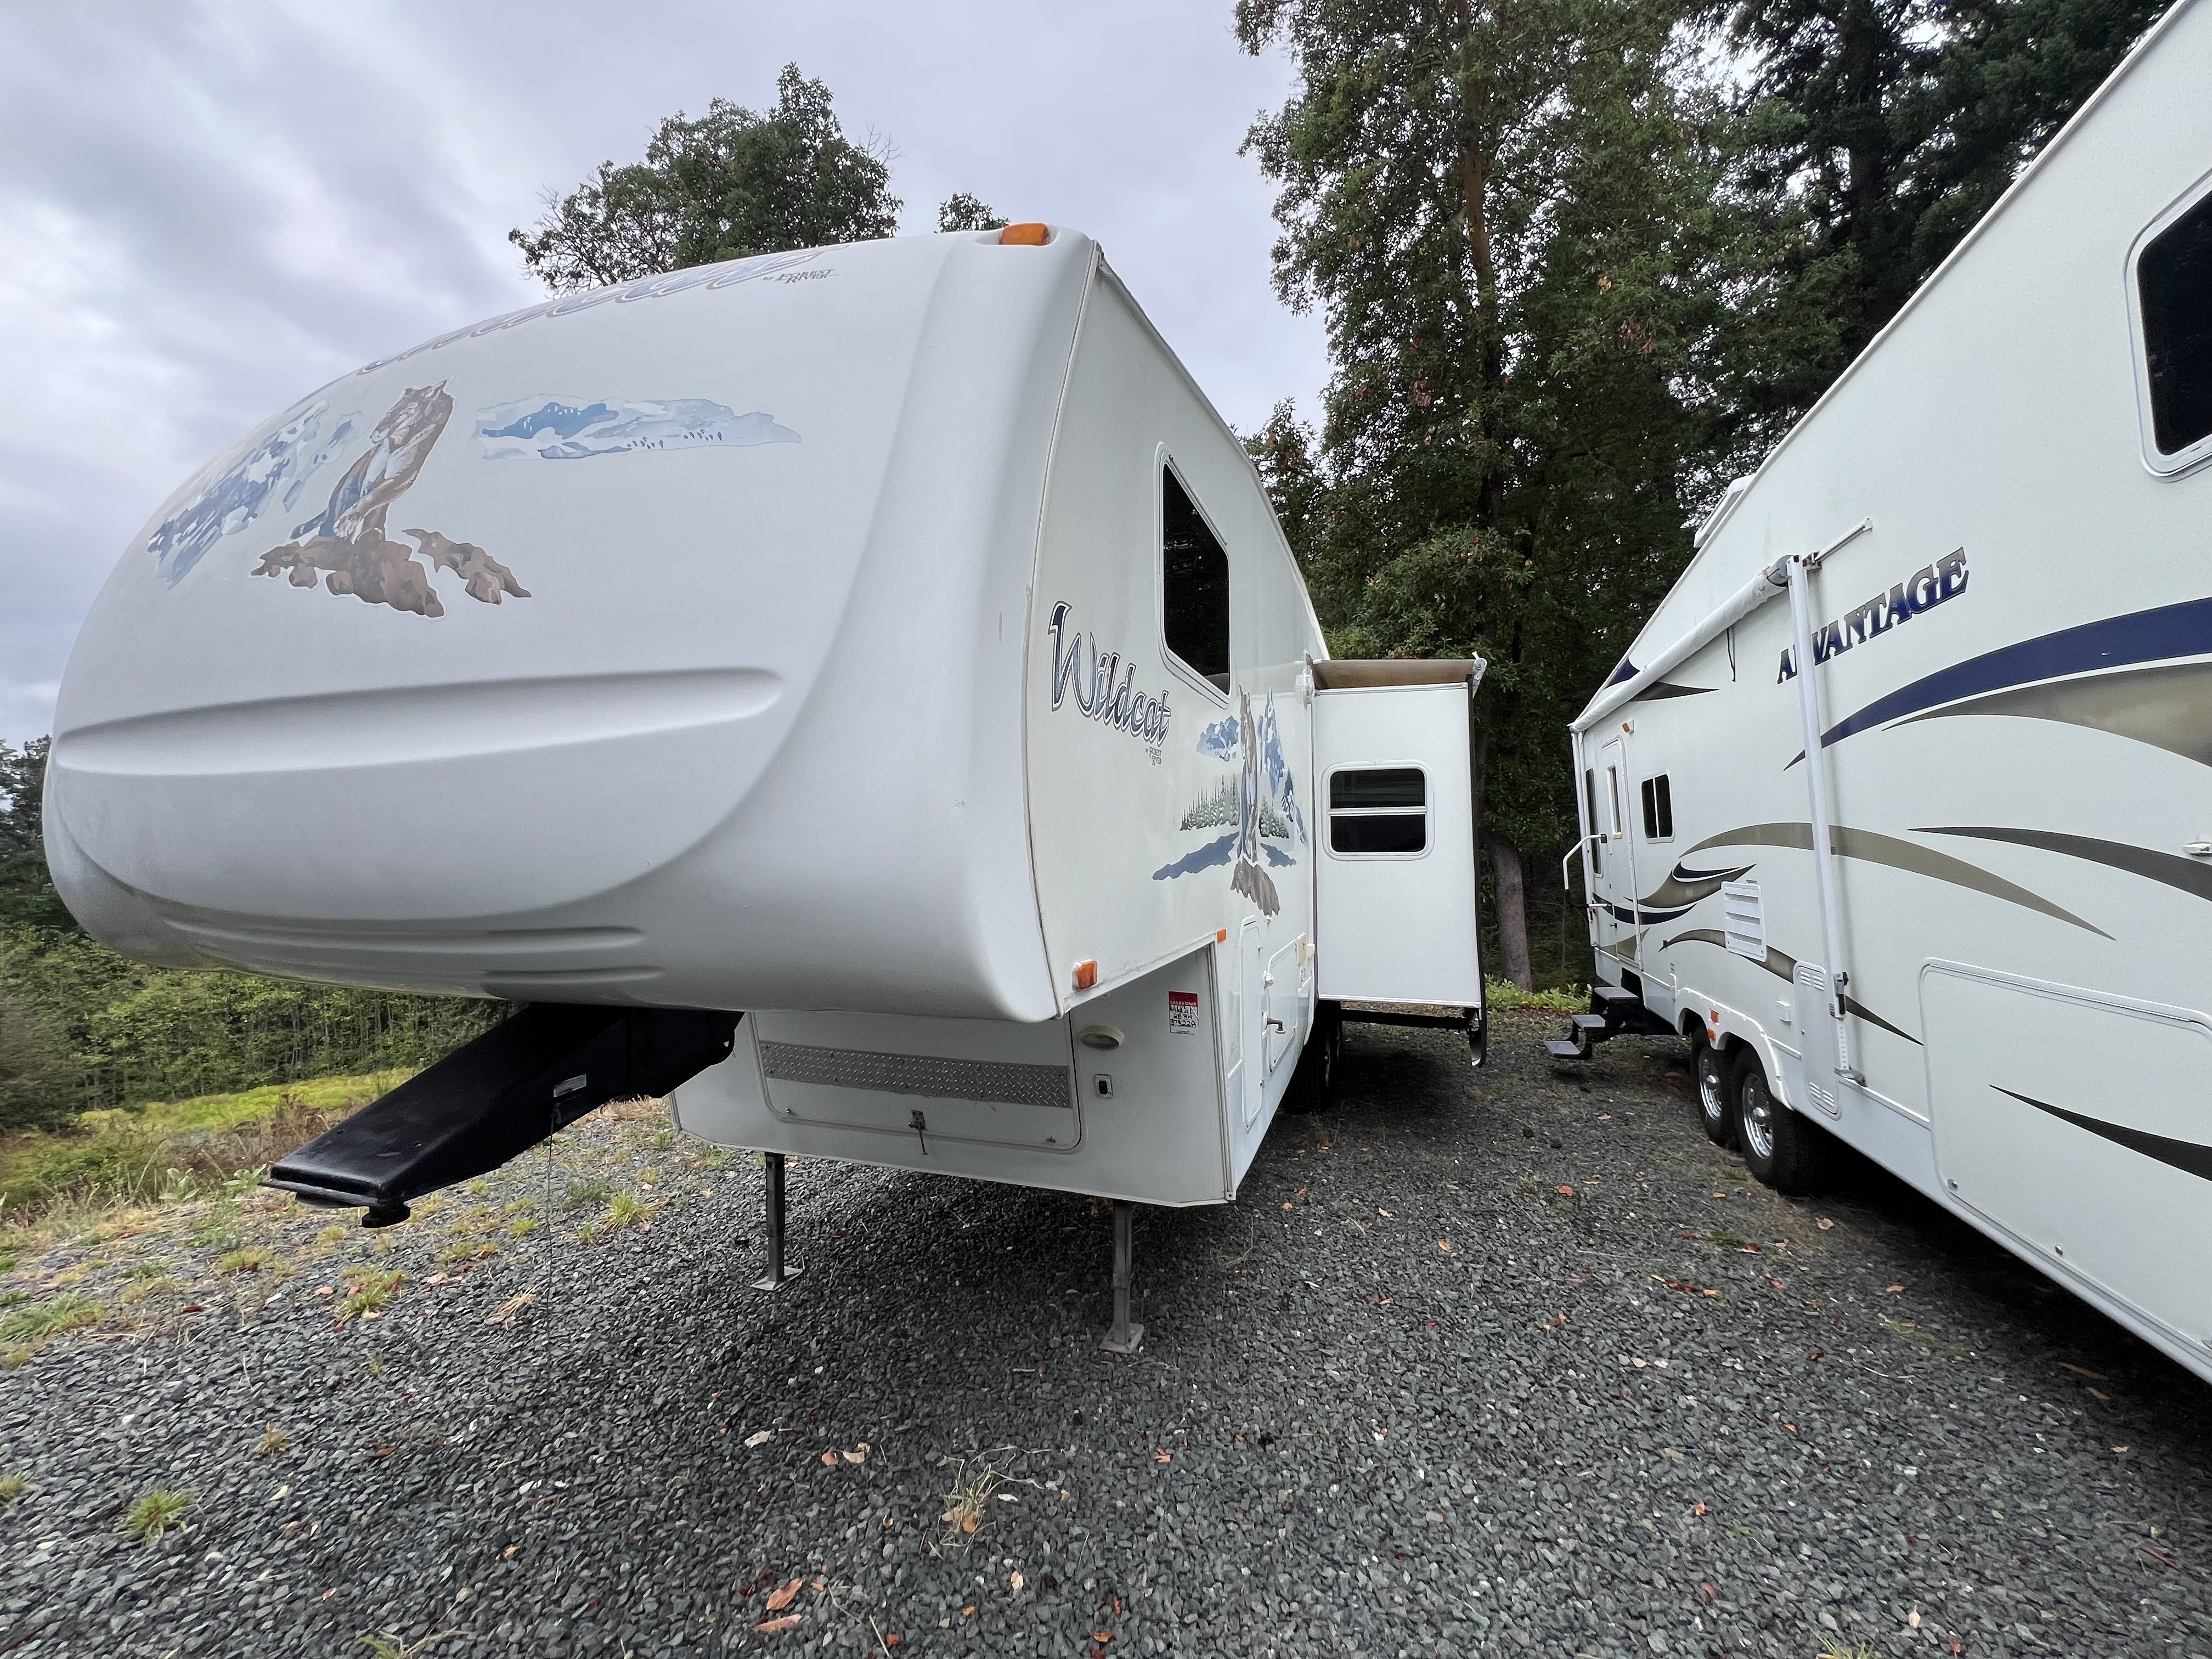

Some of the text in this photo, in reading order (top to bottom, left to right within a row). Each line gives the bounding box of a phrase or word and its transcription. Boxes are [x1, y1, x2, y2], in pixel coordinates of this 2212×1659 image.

[774, 269, 835, 281] FOREST
[783, 273, 829, 284] RIVER
[1776, 546, 1970, 685] AVANTAGE
[1047, 600, 1171, 747] Wildcat
